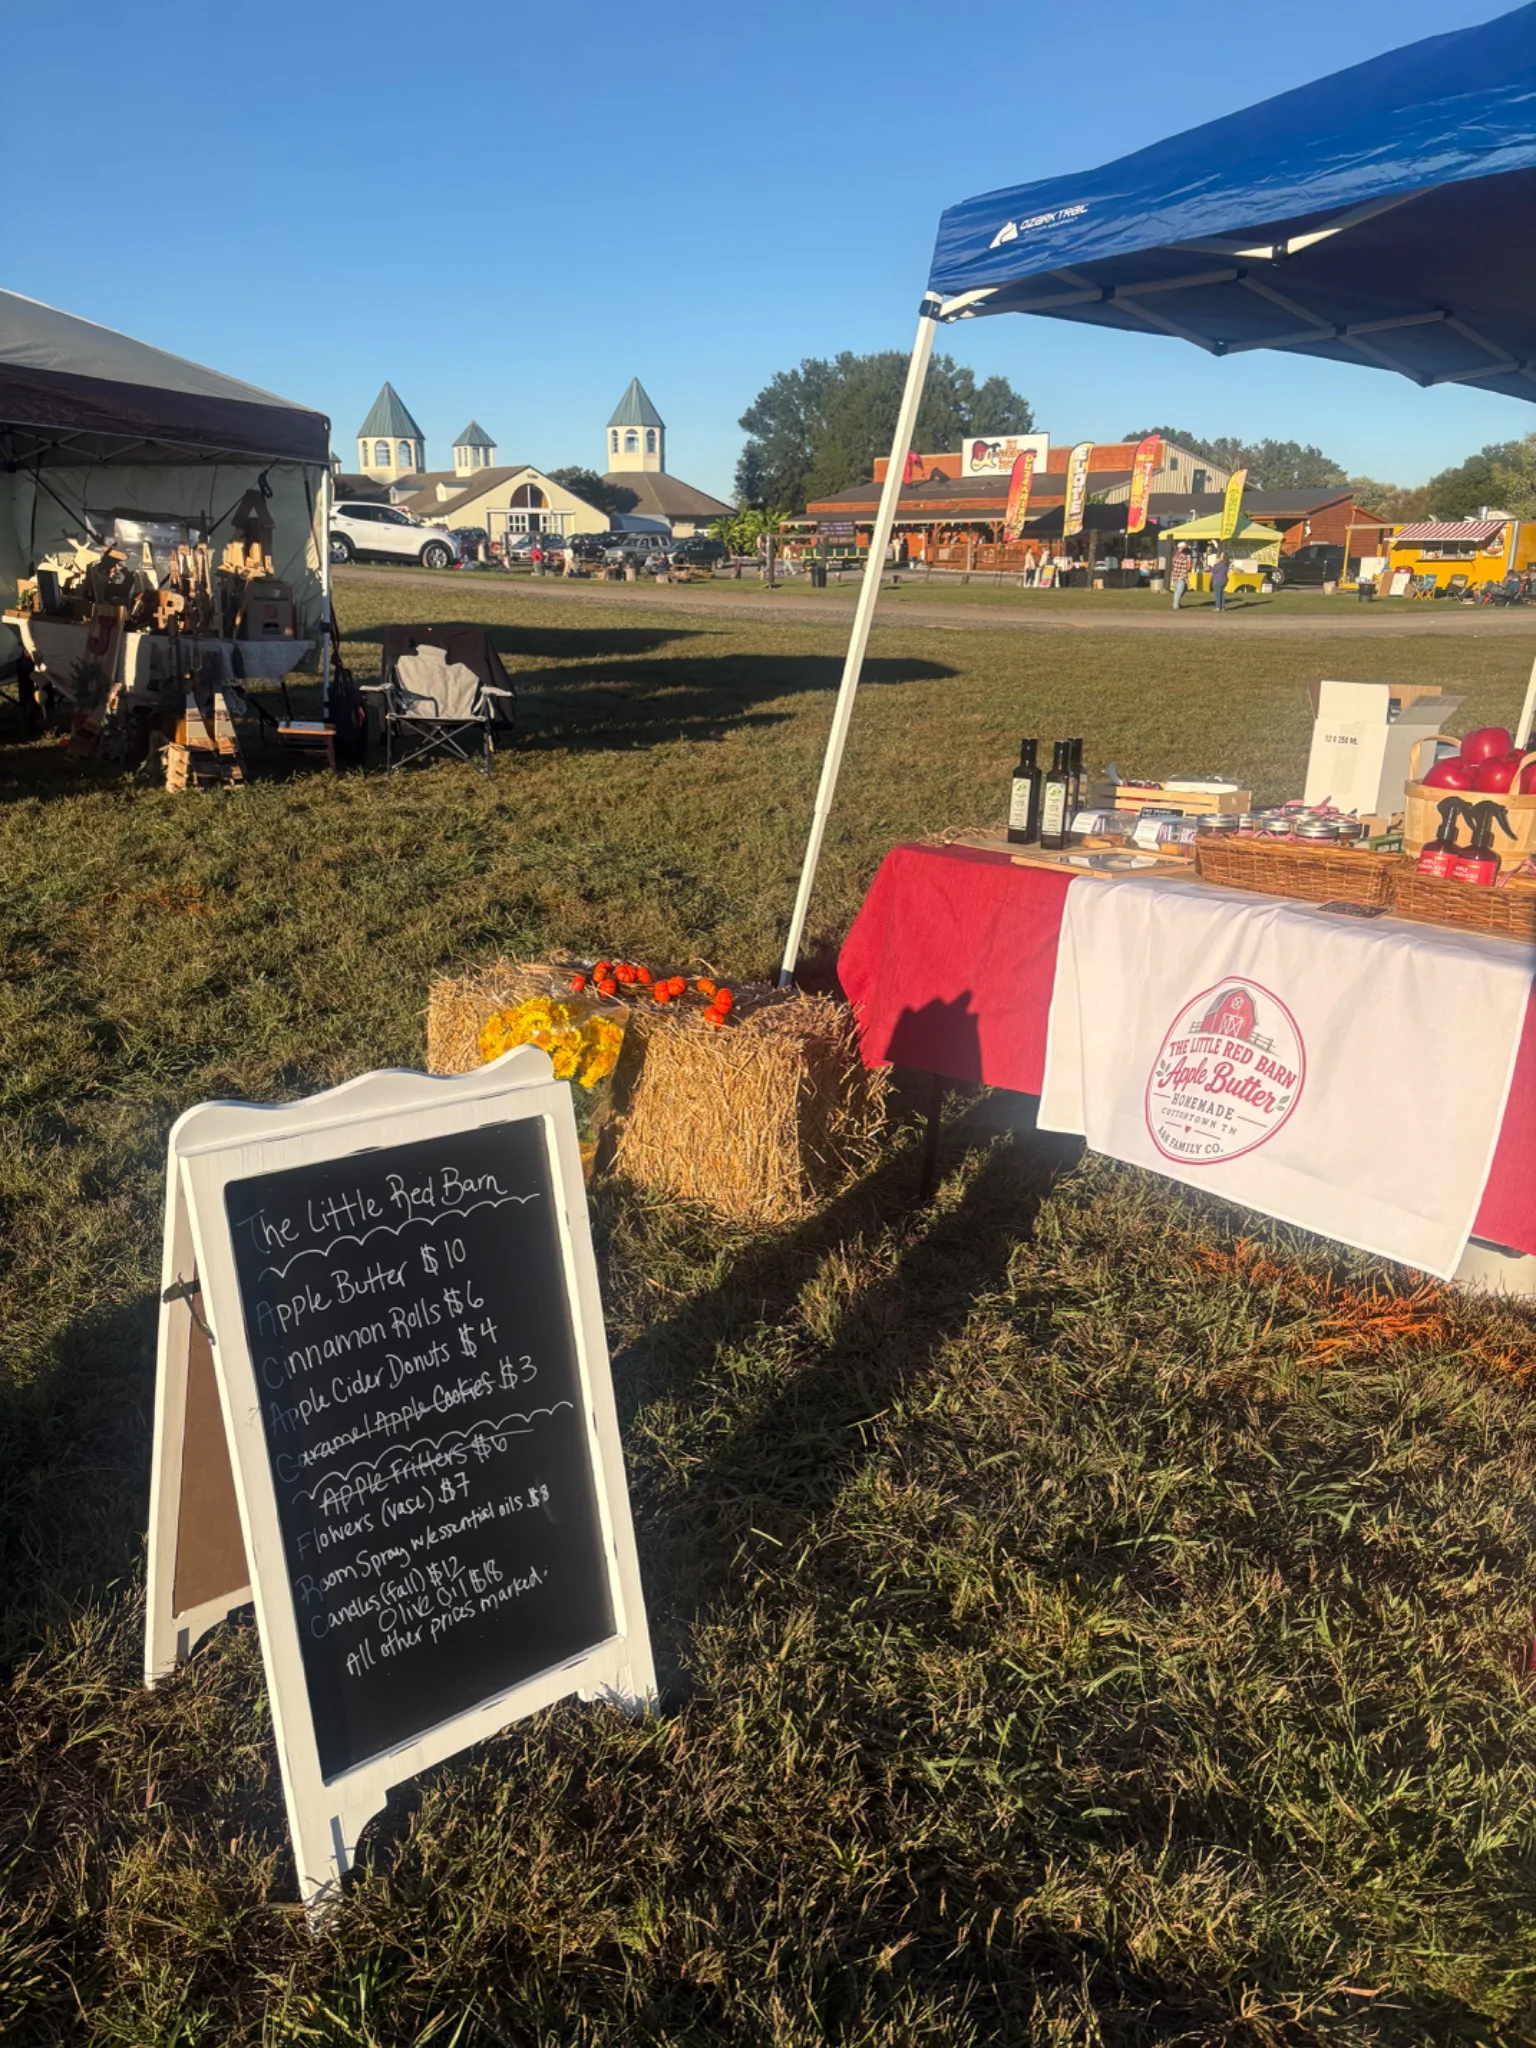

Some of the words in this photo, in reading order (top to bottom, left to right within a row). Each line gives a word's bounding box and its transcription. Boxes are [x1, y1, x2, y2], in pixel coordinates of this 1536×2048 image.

[1158, 1055, 1209, 1092] Apple
[1204, 1061, 1276, 1114] Butter
[1169, 1039, 1190, 1057] THE
[1190, 1036, 1222, 1056] LITTLE
[1222, 1040, 1254, 1065] RED
[1254, 1055, 1297, 1090] BARN
[1171, 1092, 1235, 1120] HOMEMADE
[1168, 1137, 1203, 1154] FAMILY
[1204, 1143, 1224, 1154] CO.
[238, 1209, 299, 1254] The
[308, 1189, 383, 1233] Little
[386, 1174, 436, 1218] Red
[441, 1168, 508, 1205] Barn
[257, 1285, 331, 1337] Apple
[331, 1261, 409, 1303] Butter
[262, 1321, 387, 1389] Cinnamon
[391, 1299, 441, 1339] Rolls
[269, 1386, 331, 1438] Apple
[332, 1365, 384, 1403] Cider
[386, 1343, 451, 1390] Donuts
[374, 1401, 430, 1435] Apple
[499, 1355, 538, 1390] $3
[295, 1565, 358, 1605] Room
[356, 1546, 411, 1577] Spray
[499, 1495, 523, 1517] oils
[297, 1513, 374, 1561] Flowers
[381, 1485, 434, 1528] (vase)
[438, 1472, 470, 1504] $7
[311, 1594, 381, 1638] Candles
[380, 1567, 426, 1605] (fall)
[425, 1556, 466, 1587] $12
[378, 1595, 435, 1633] Olive
[436, 1577, 469, 1607] Oil
[468, 1558, 503, 1593] $18
[345, 1638, 376, 1677] All
[380, 1625, 423, 1658] other
[429, 1600, 476, 1643] prices
